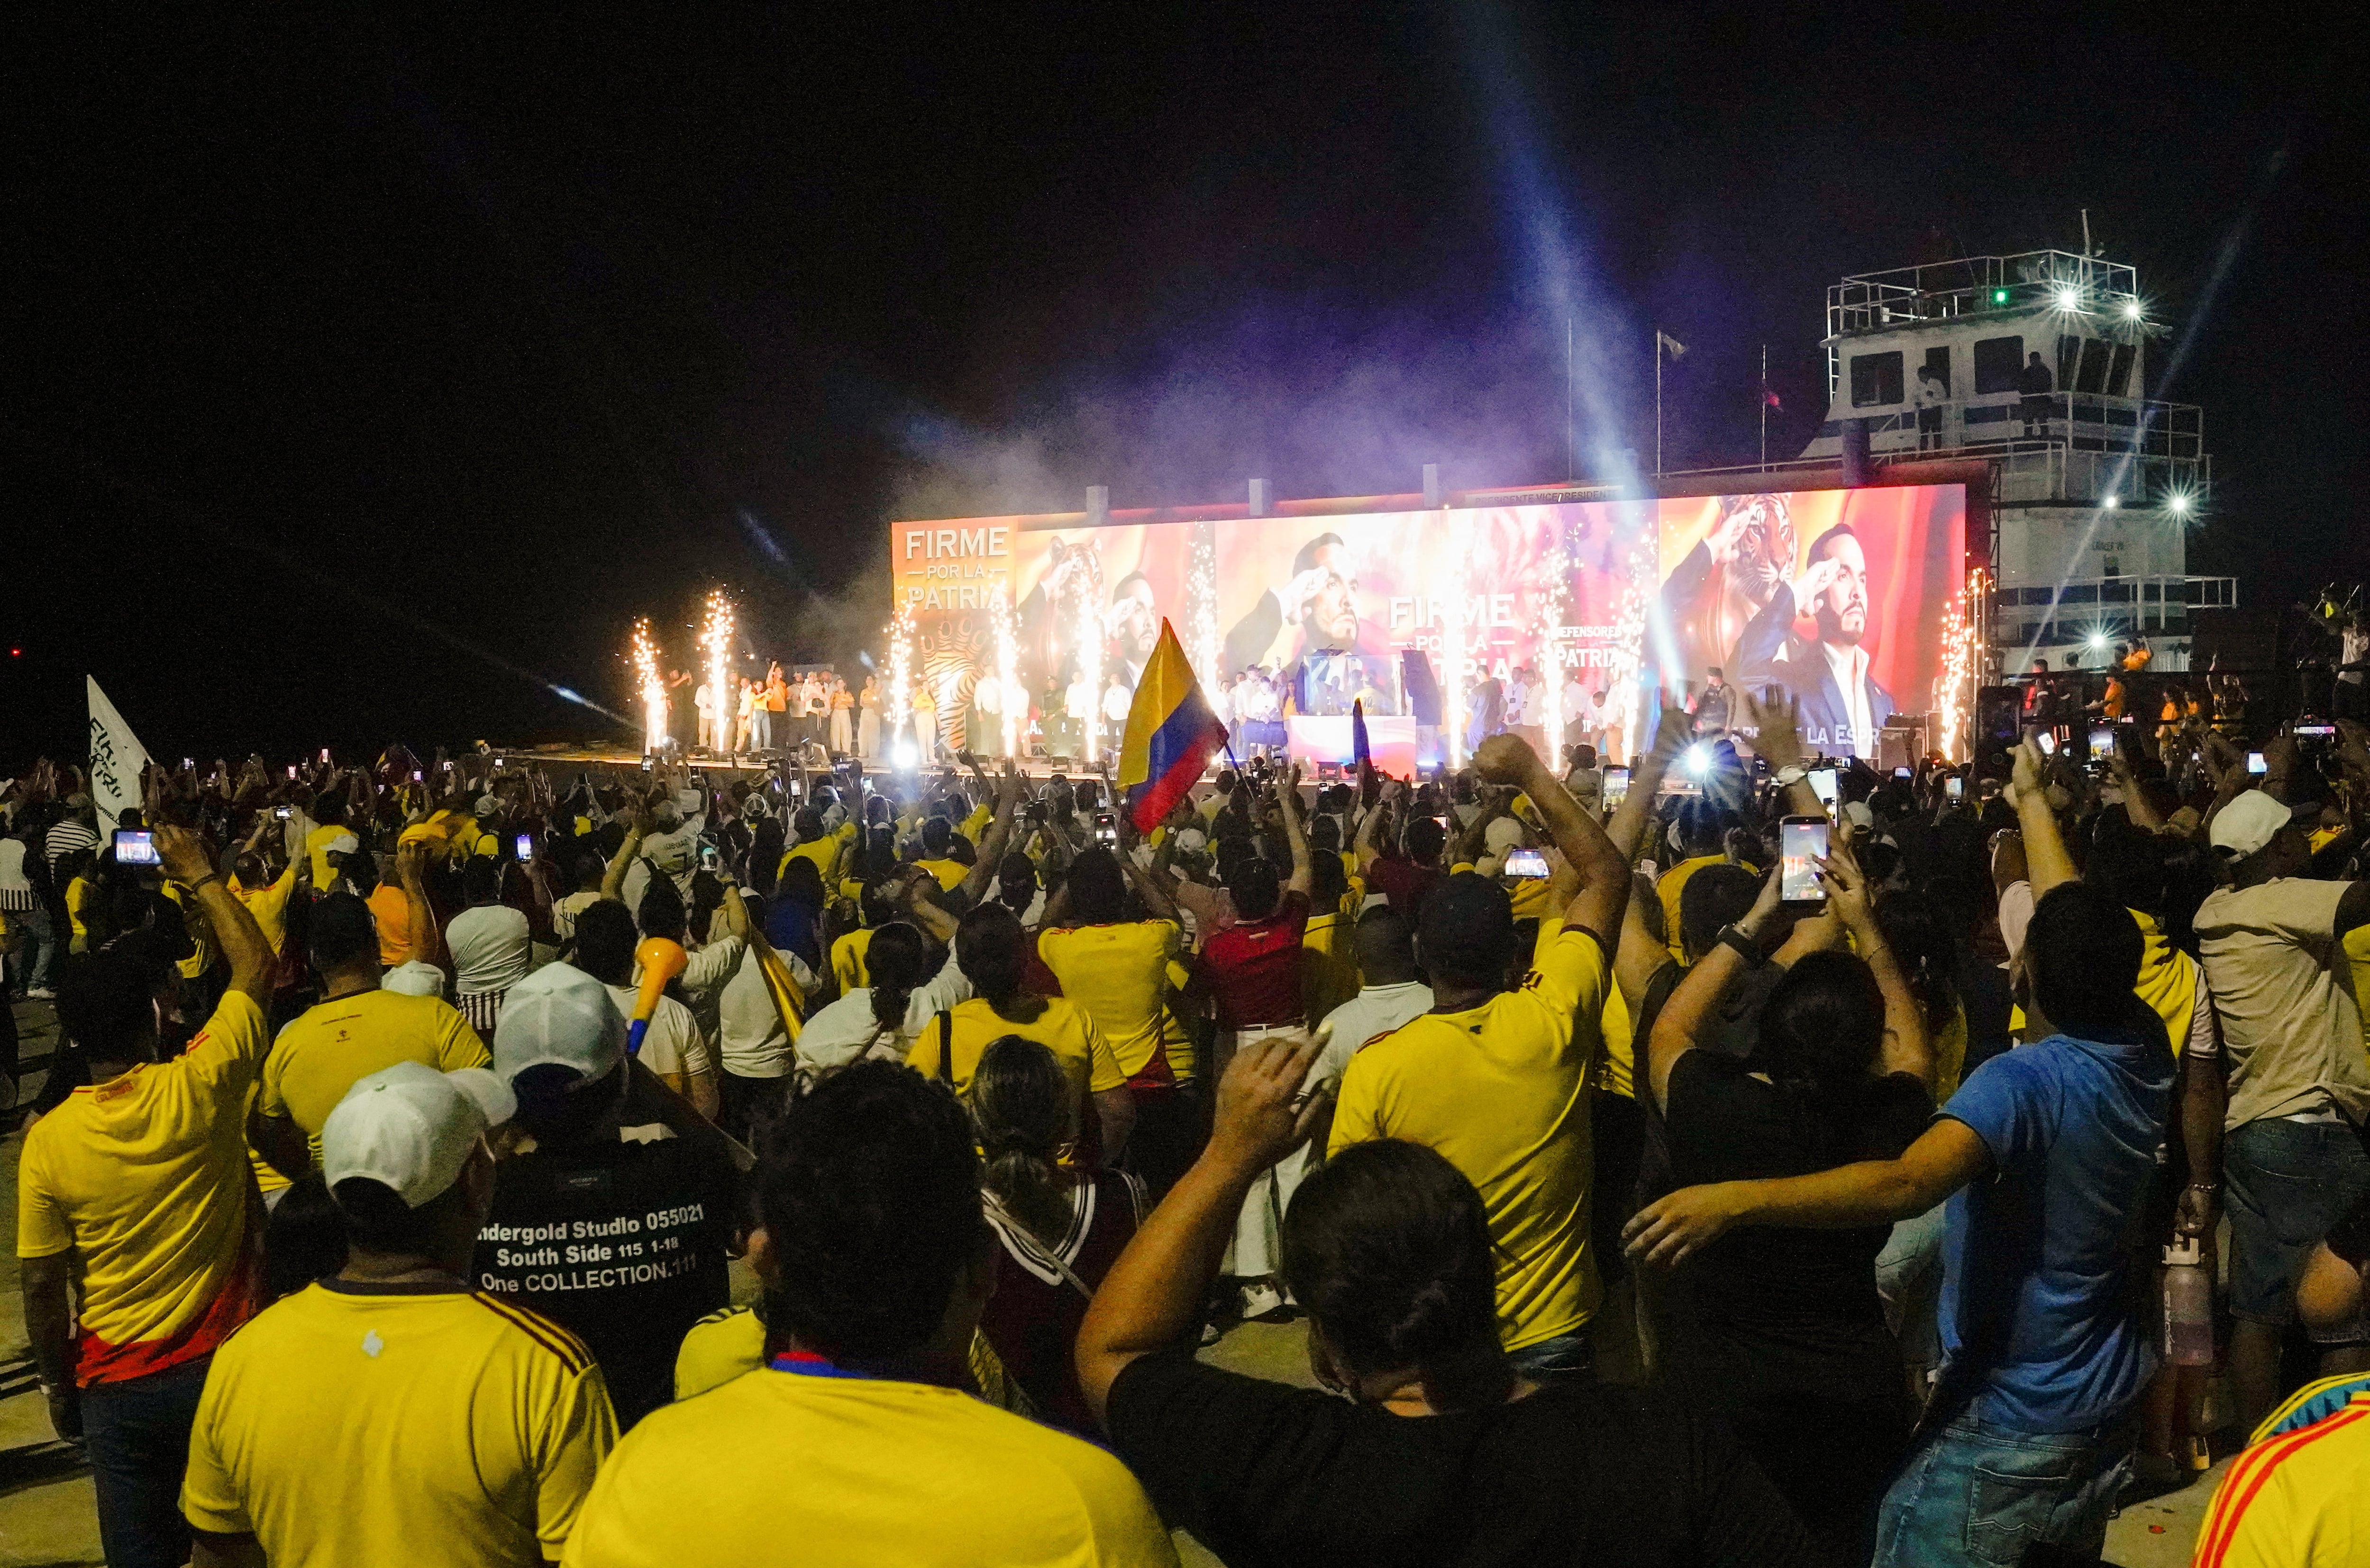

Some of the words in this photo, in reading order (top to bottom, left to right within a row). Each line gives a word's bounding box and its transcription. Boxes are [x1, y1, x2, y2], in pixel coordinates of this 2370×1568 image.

[1475, 494, 1534, 505] PRESIDENTE
[906, 526, 1009, 560] FIRME
[927, 564, 960, 580] POR
[963, 563, 985, 578] LA
[908, 585, 1006, 610] PATRIA
[1415, 635, 1447, 651] PO
[1806, 727, 1829, 744] LA
[477, 1223, 567, 1246] ndergold
[646, 1203, 704, 1231] 055021
[497, 1247, 559, 1267] South
[565, 1243, 612, 1264] Side
[618, 1242, 643, 1258] 115
[481, 1273, 520, 1293] One
